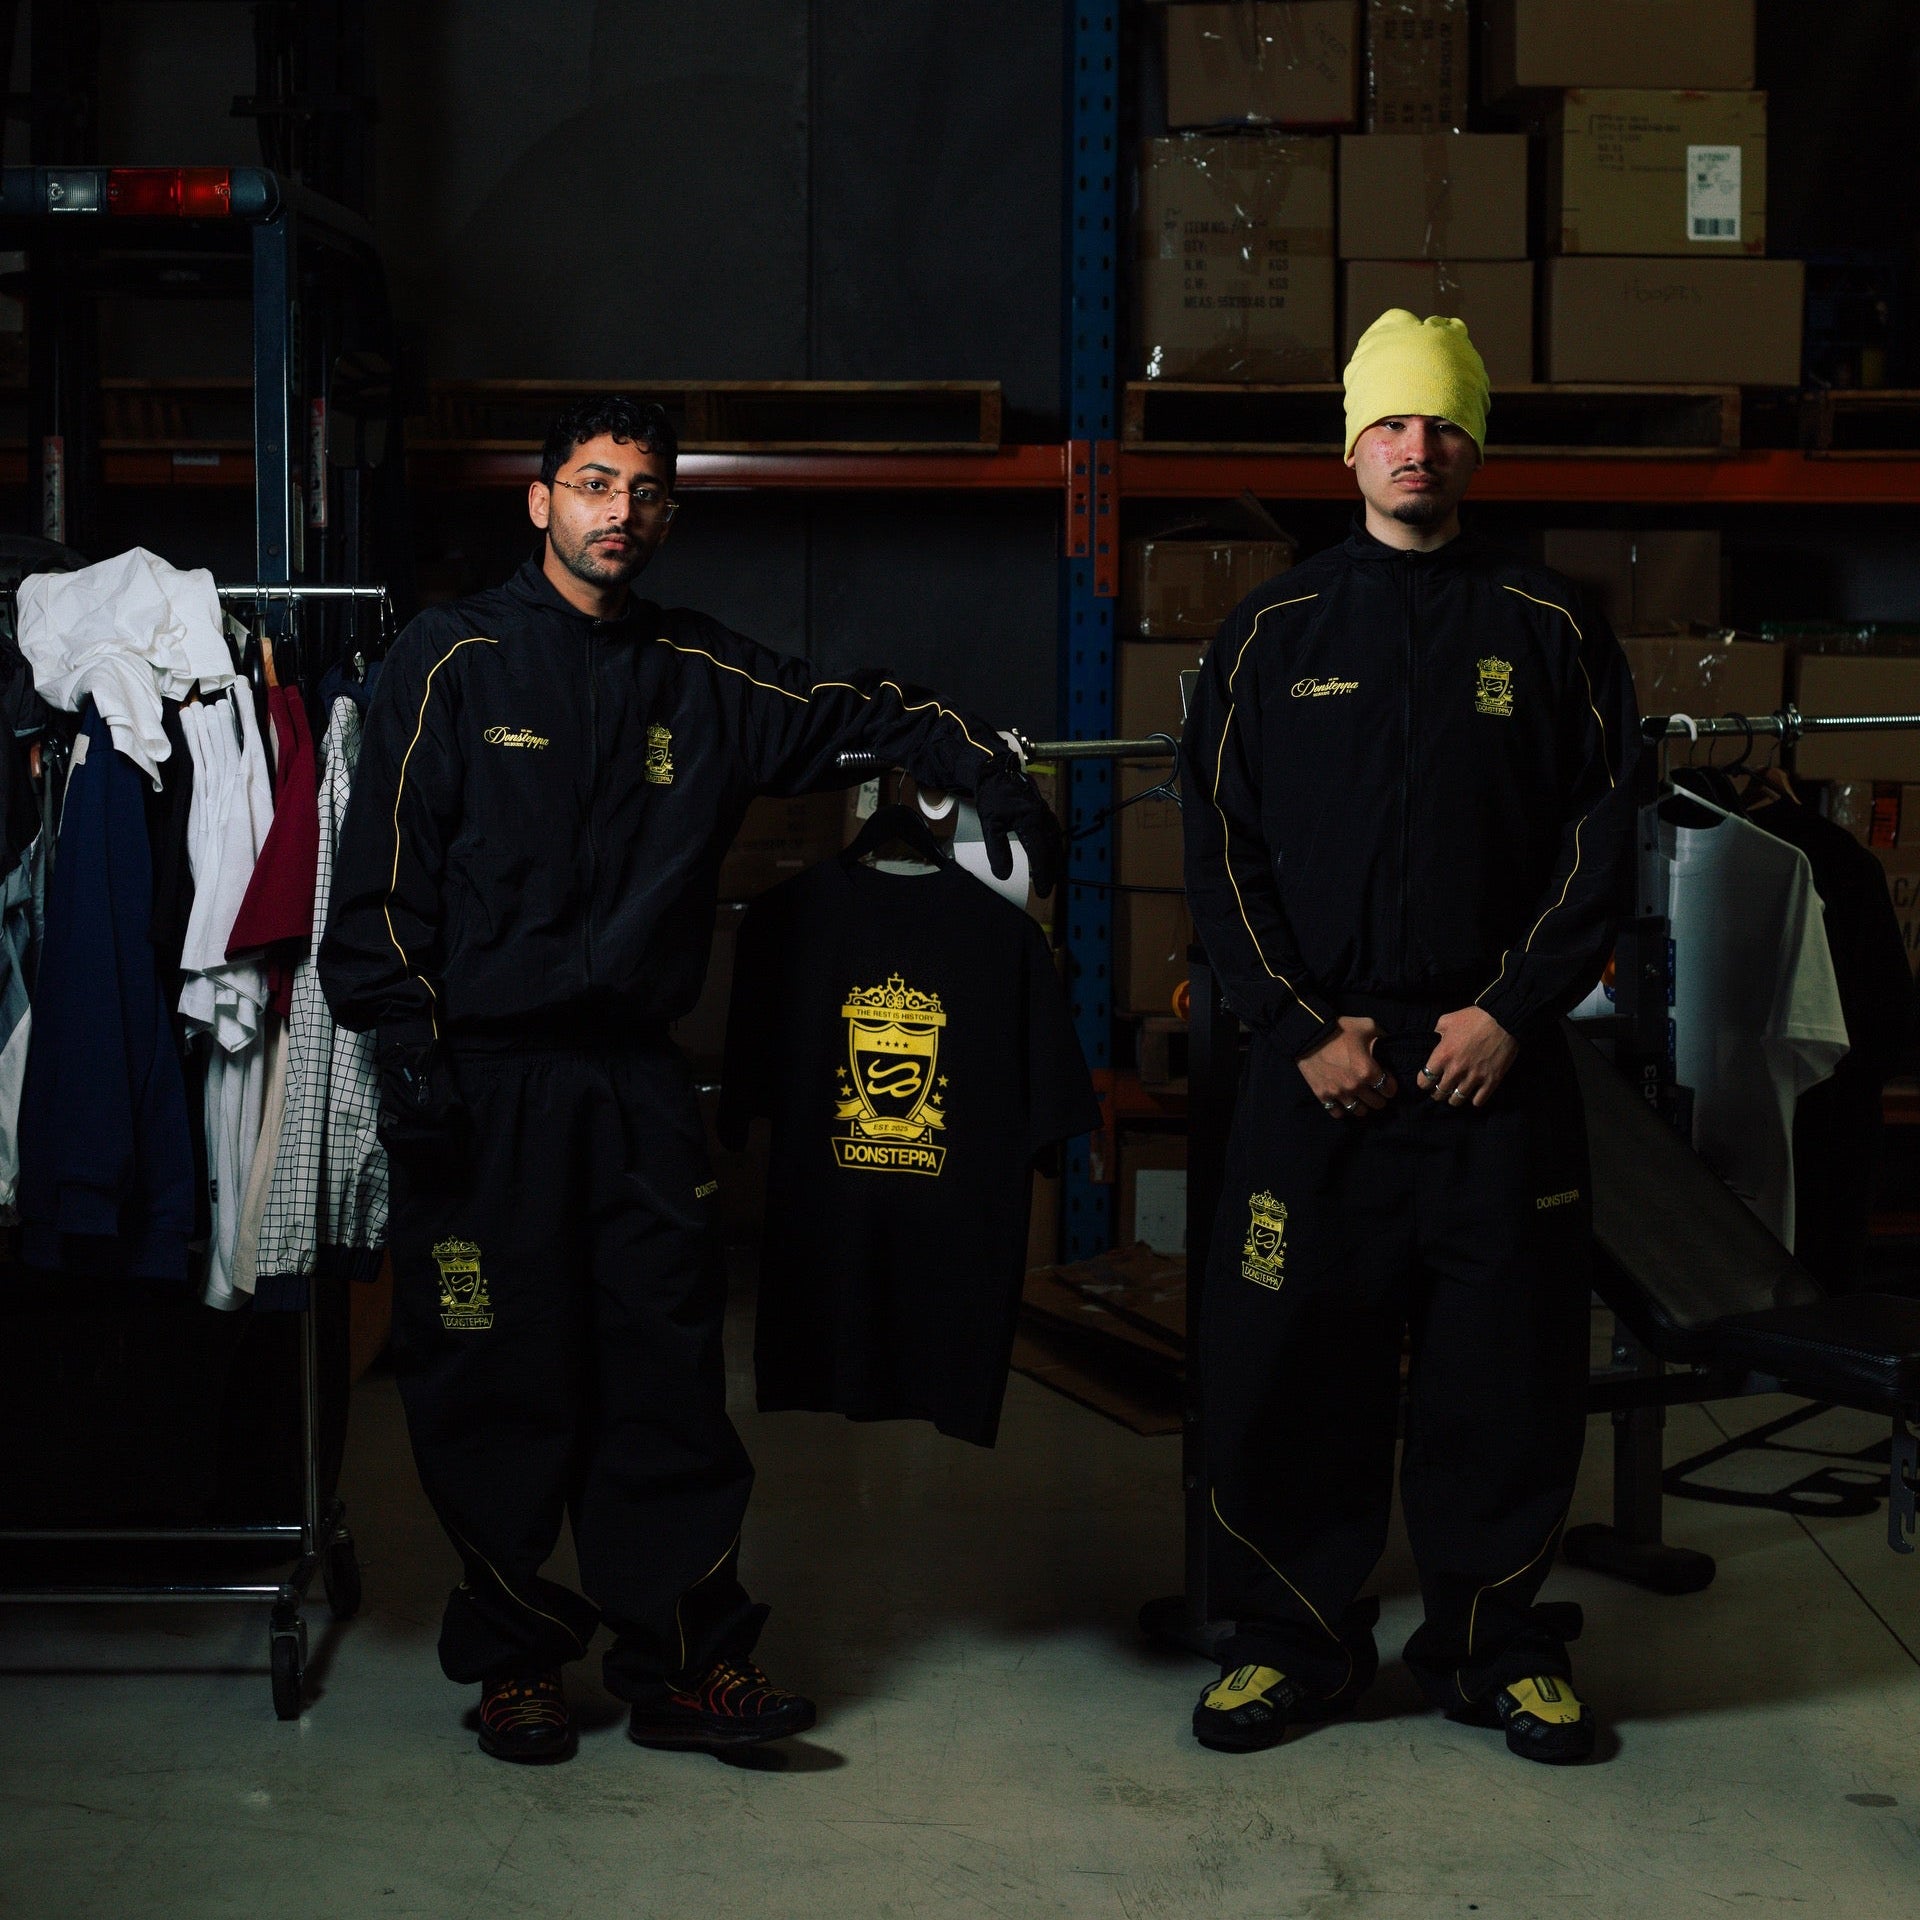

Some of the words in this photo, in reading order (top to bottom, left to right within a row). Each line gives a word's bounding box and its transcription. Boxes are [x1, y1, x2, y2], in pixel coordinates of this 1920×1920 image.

[1268, 258, 1289, 271] KGS
[1268, 277, 1289, 290] KGS
[1290, 678, 1360, 698] Donsteppa
[483, 726, 550, 749] Donsteppa
[856, 1008, 872, 1017] THE
[873, 1010, 892, 1018] REST
[901, 1013, 935, 1022] HISTORY
[891, 1124, 909, 1132] 2025
[844, 1143, 938, 1170] DONSTEPPA
[1244, 1265, 1280, 1287] DONSTEPPA
[446, 1316, 491, 1327] DONSTEPPA
